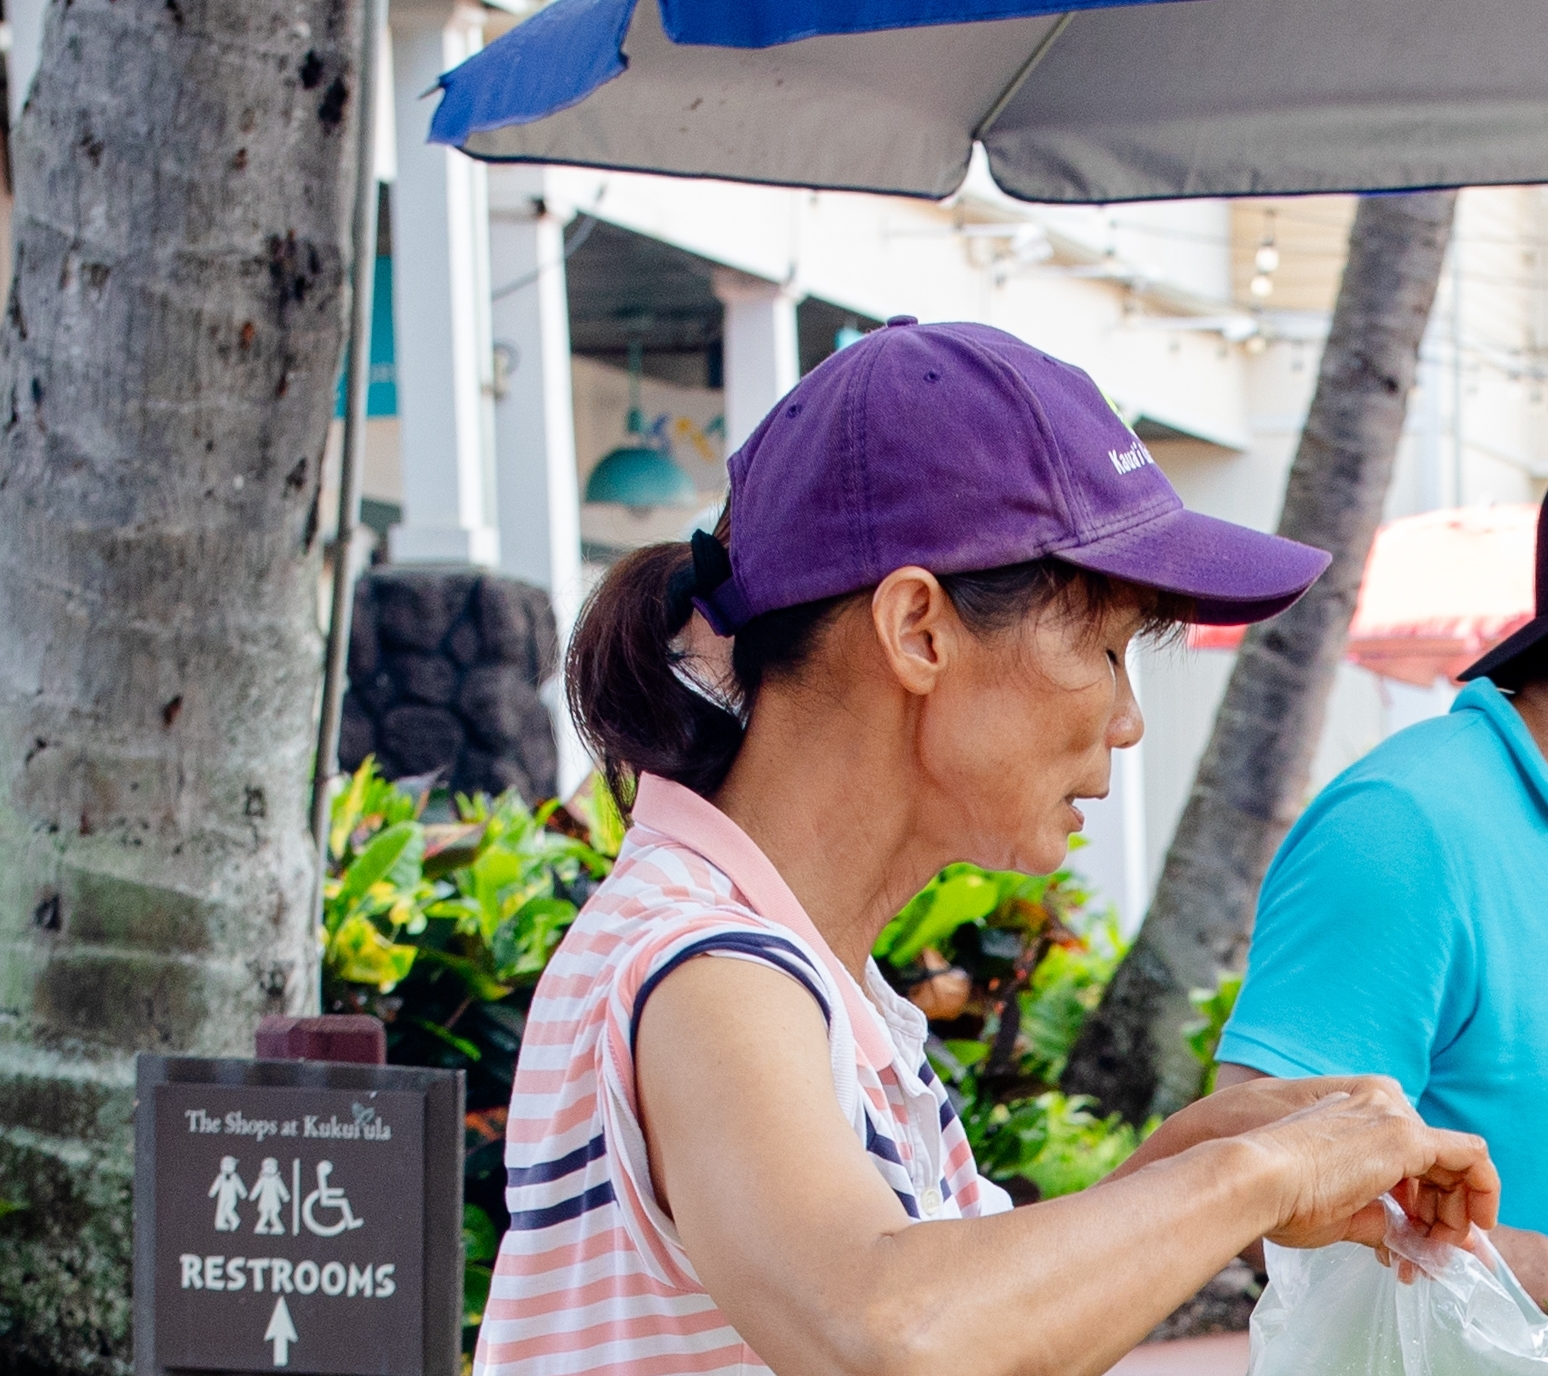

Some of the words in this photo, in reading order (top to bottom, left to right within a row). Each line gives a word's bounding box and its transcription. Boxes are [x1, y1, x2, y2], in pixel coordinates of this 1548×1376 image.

[184, 1109, 221, 1133] The
[224, 1110, 278, 1142] Shops
[280, 1119, 299, 1136] at
[179, 1254, 396, 1298] RESTROOMS
